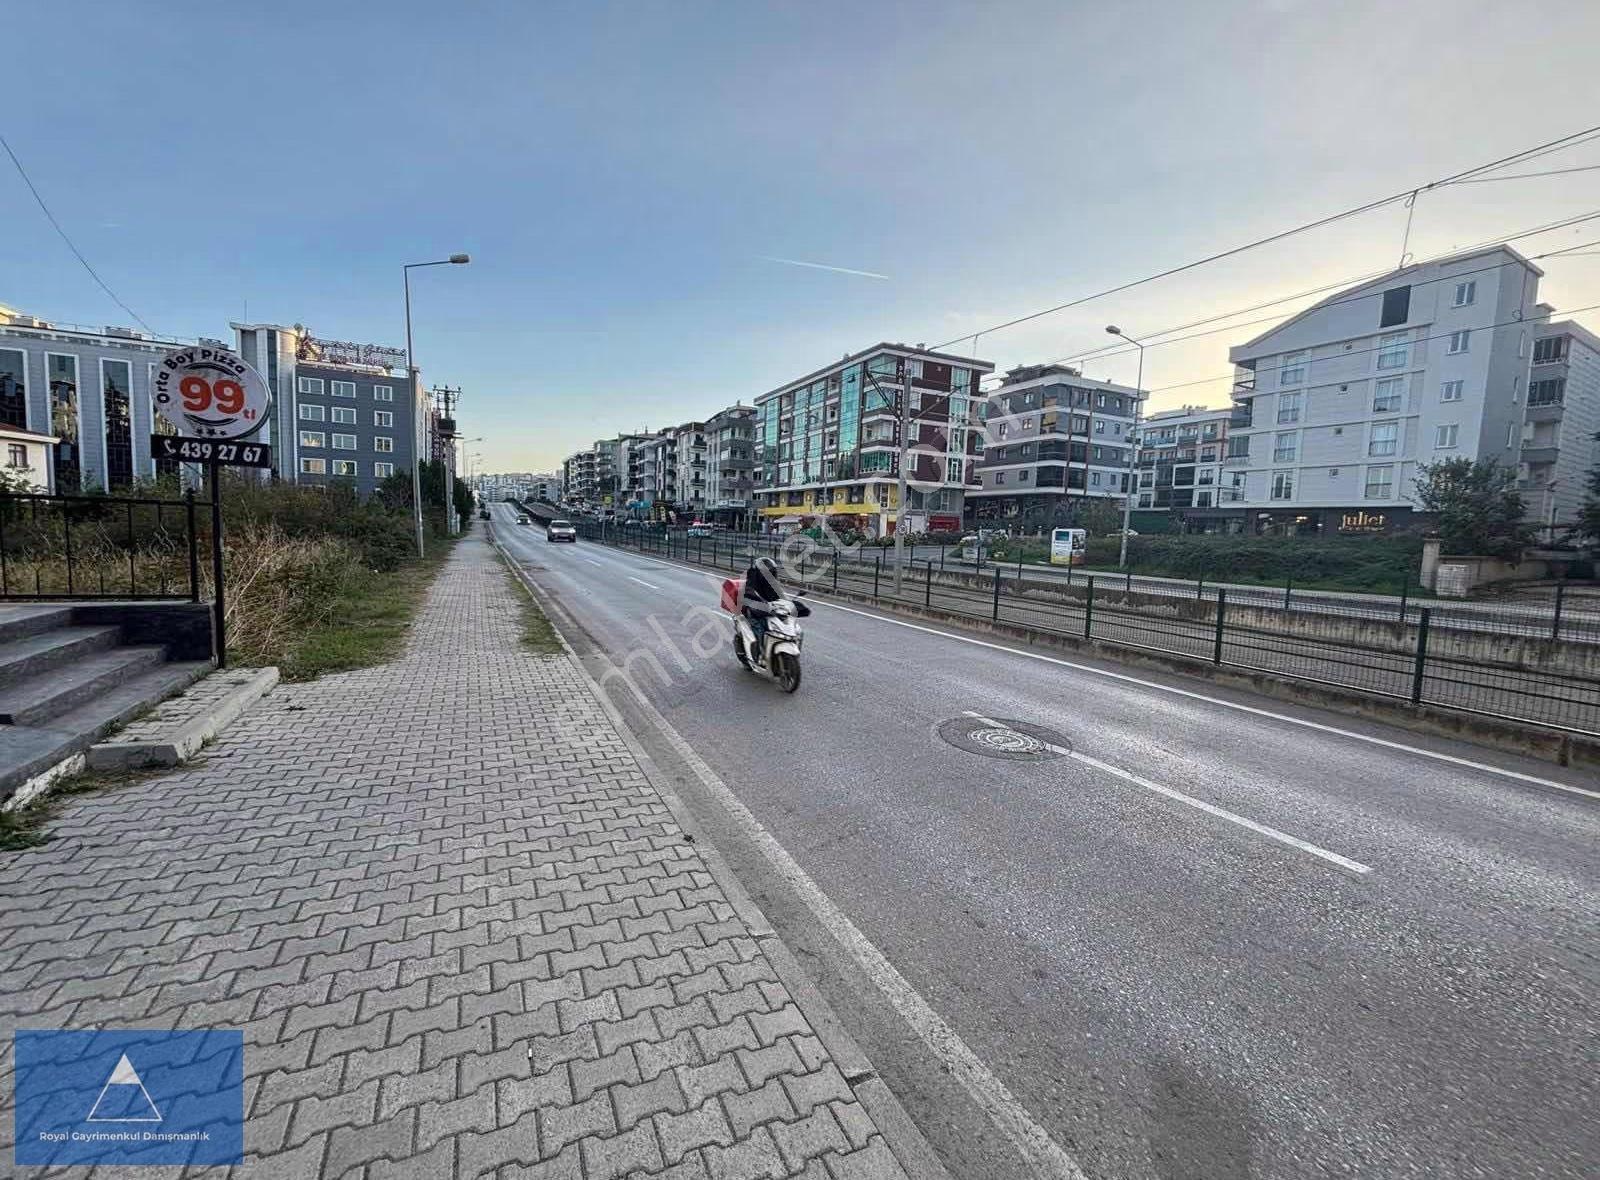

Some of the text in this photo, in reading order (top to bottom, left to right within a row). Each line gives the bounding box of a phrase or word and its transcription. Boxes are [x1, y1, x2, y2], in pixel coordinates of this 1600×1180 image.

[156, 349, 247, 404] Orta Boy Pizza
[179, 376, 245, 415] 99
[180, 441, 263, 463] 439 27 67
